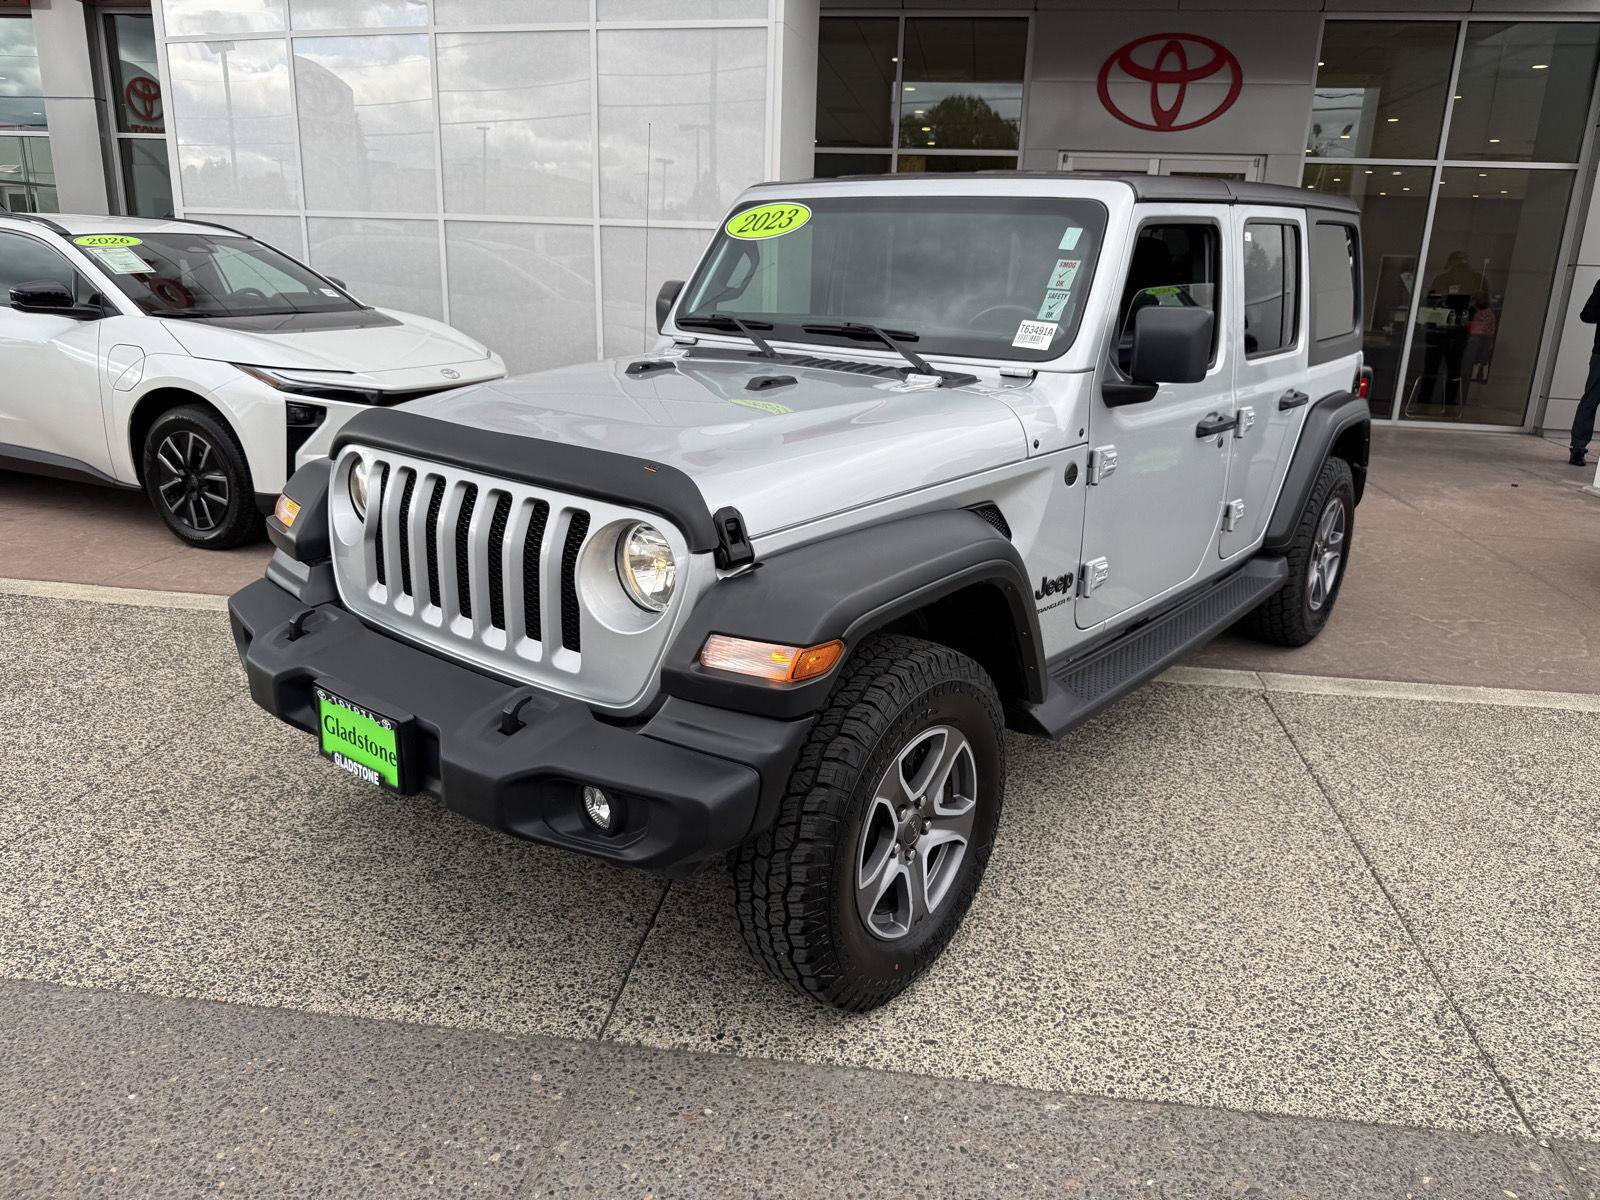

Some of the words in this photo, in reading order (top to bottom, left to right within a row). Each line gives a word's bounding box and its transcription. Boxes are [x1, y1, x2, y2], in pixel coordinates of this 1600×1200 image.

[737, 208, 800, 233] 2023
[86, 237, 130, 245] 2026
[1059, 261, 1077, 269] SMOG
[1047, 292, 1069, 300] SAFETY
[1020, 324, 1054, 336] T63491A
[1035, 572, 1074, 600] Jeep
[331, 696, 376, 721] TOYOTA
[323, 714, 397, 767] Gladstone
[334, 752, 380, 786] GLADSTONE
